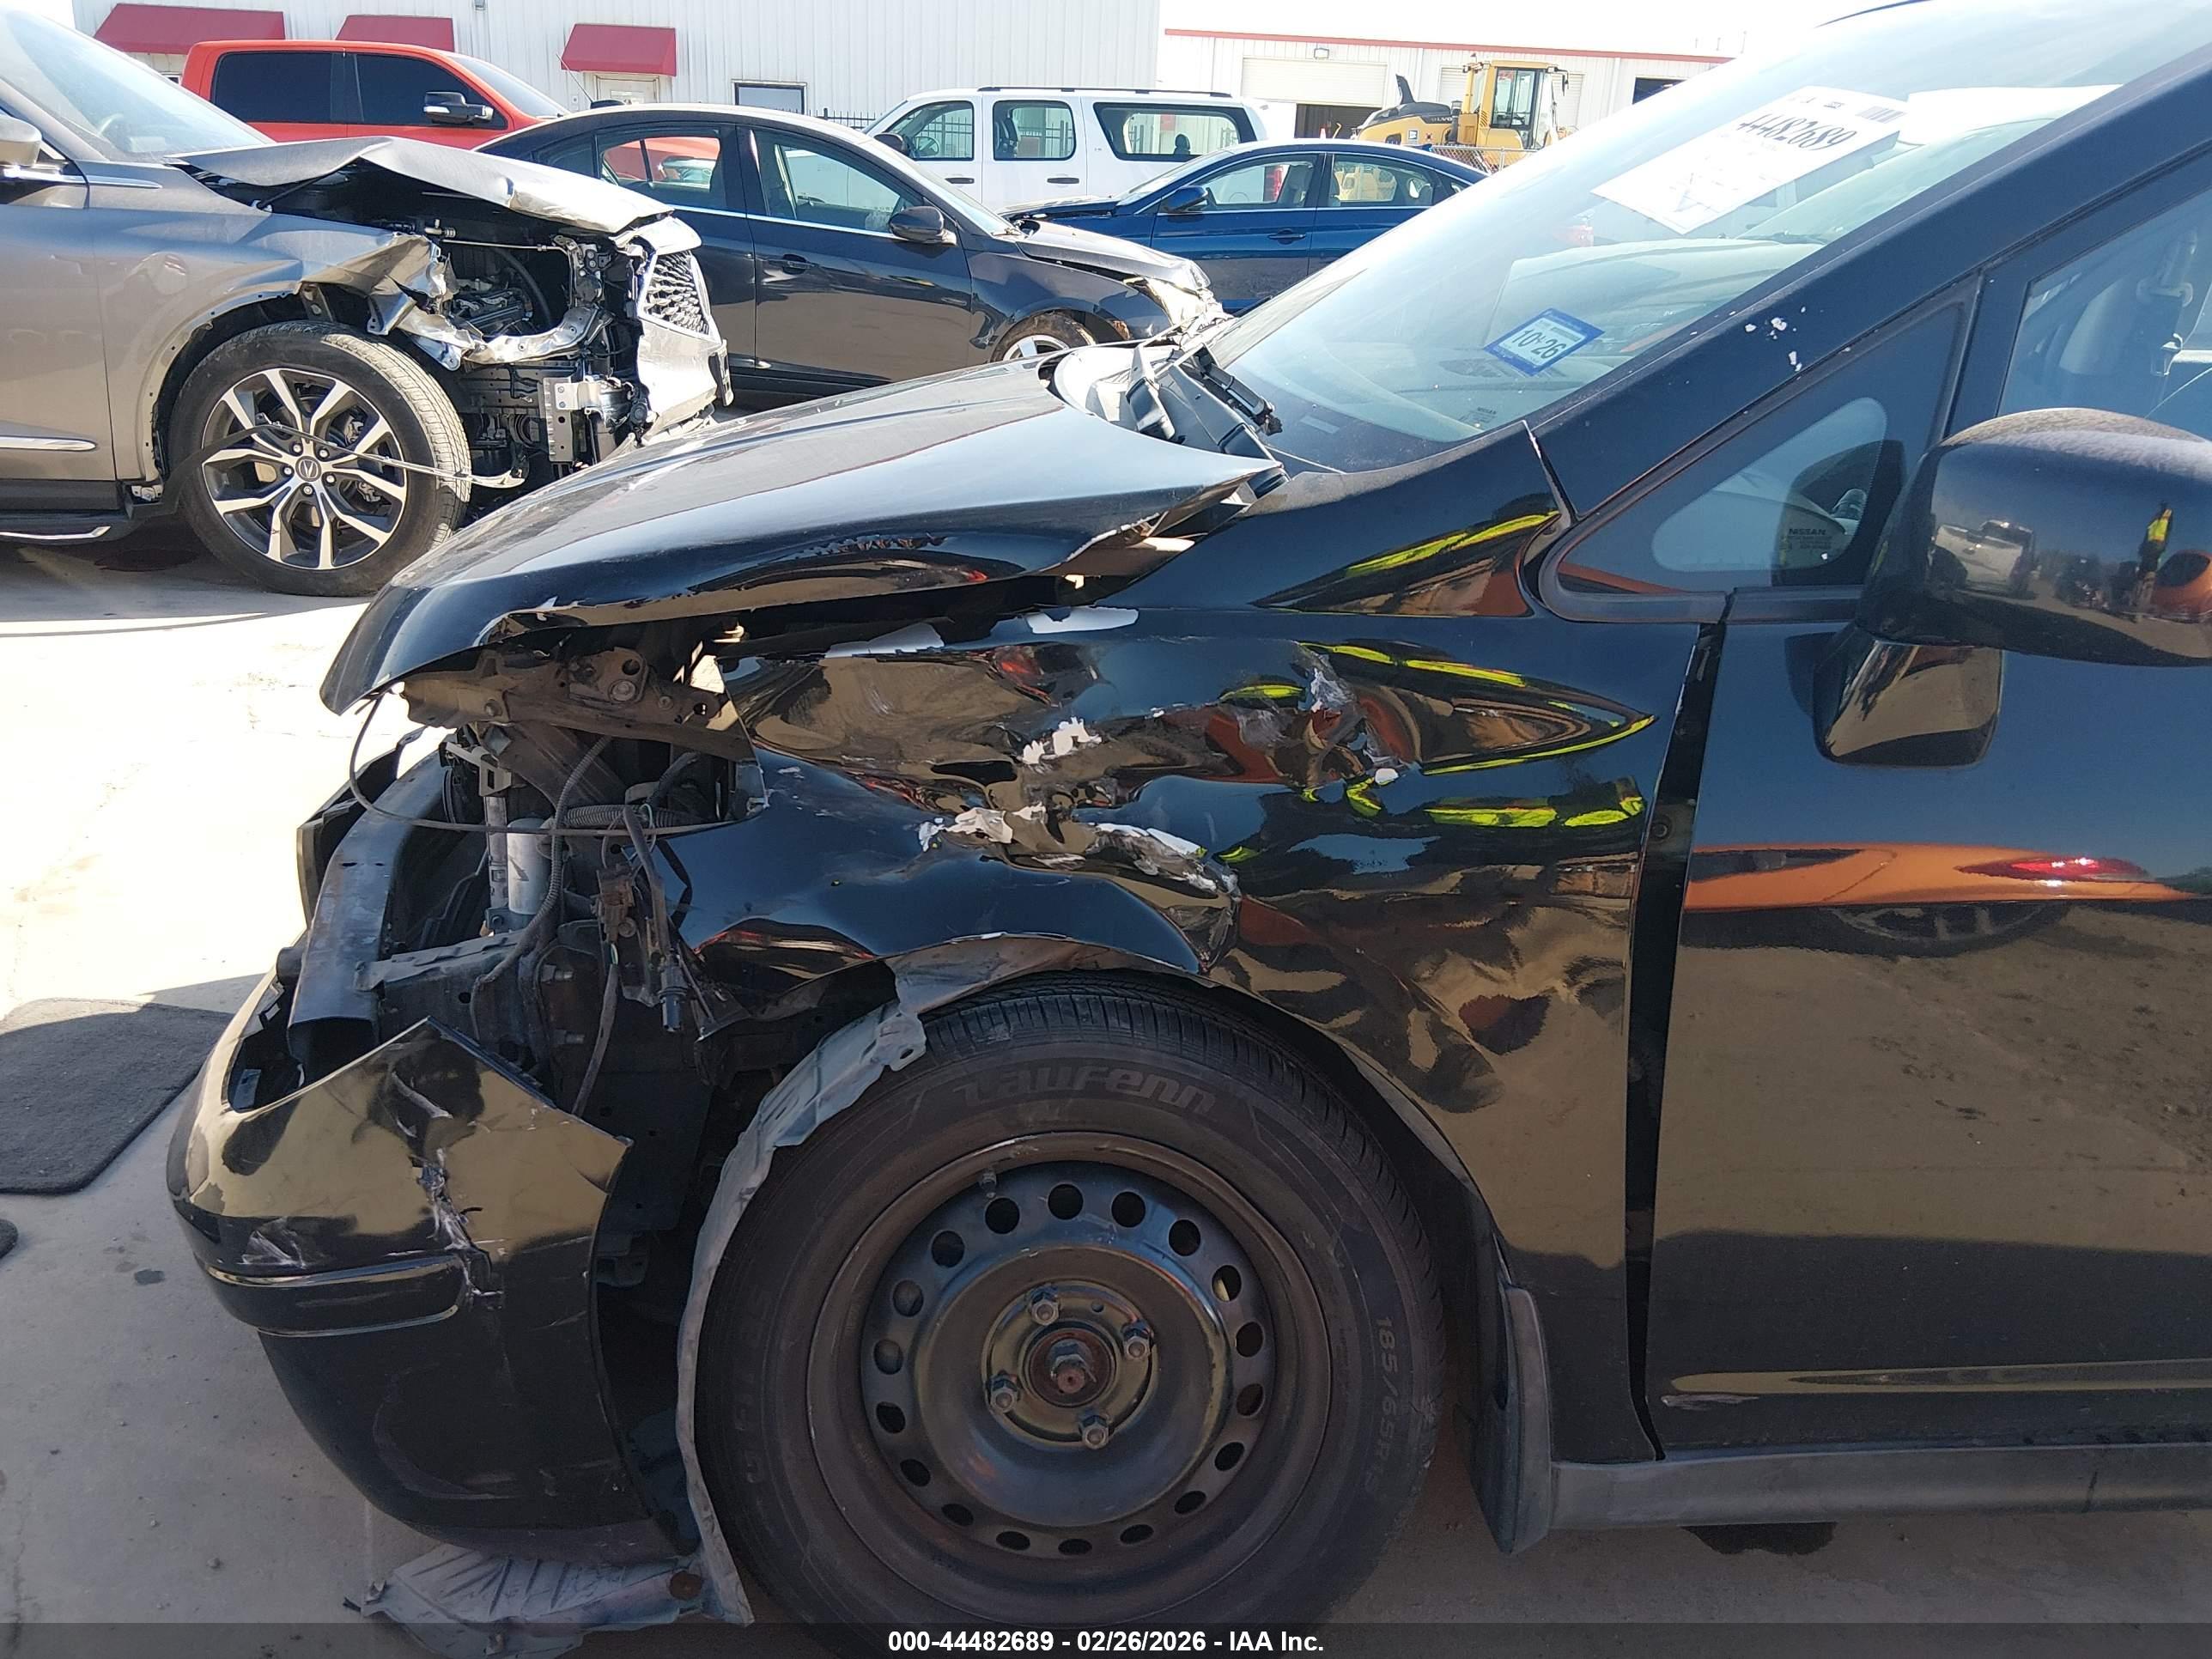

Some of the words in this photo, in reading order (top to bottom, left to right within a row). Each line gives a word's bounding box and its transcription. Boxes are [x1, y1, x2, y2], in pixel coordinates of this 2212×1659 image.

[1736, 112, 1857, 151] 44482689
[1511, 328, 1543, 348] 10
[1530, 338, 1567, 359] 26
